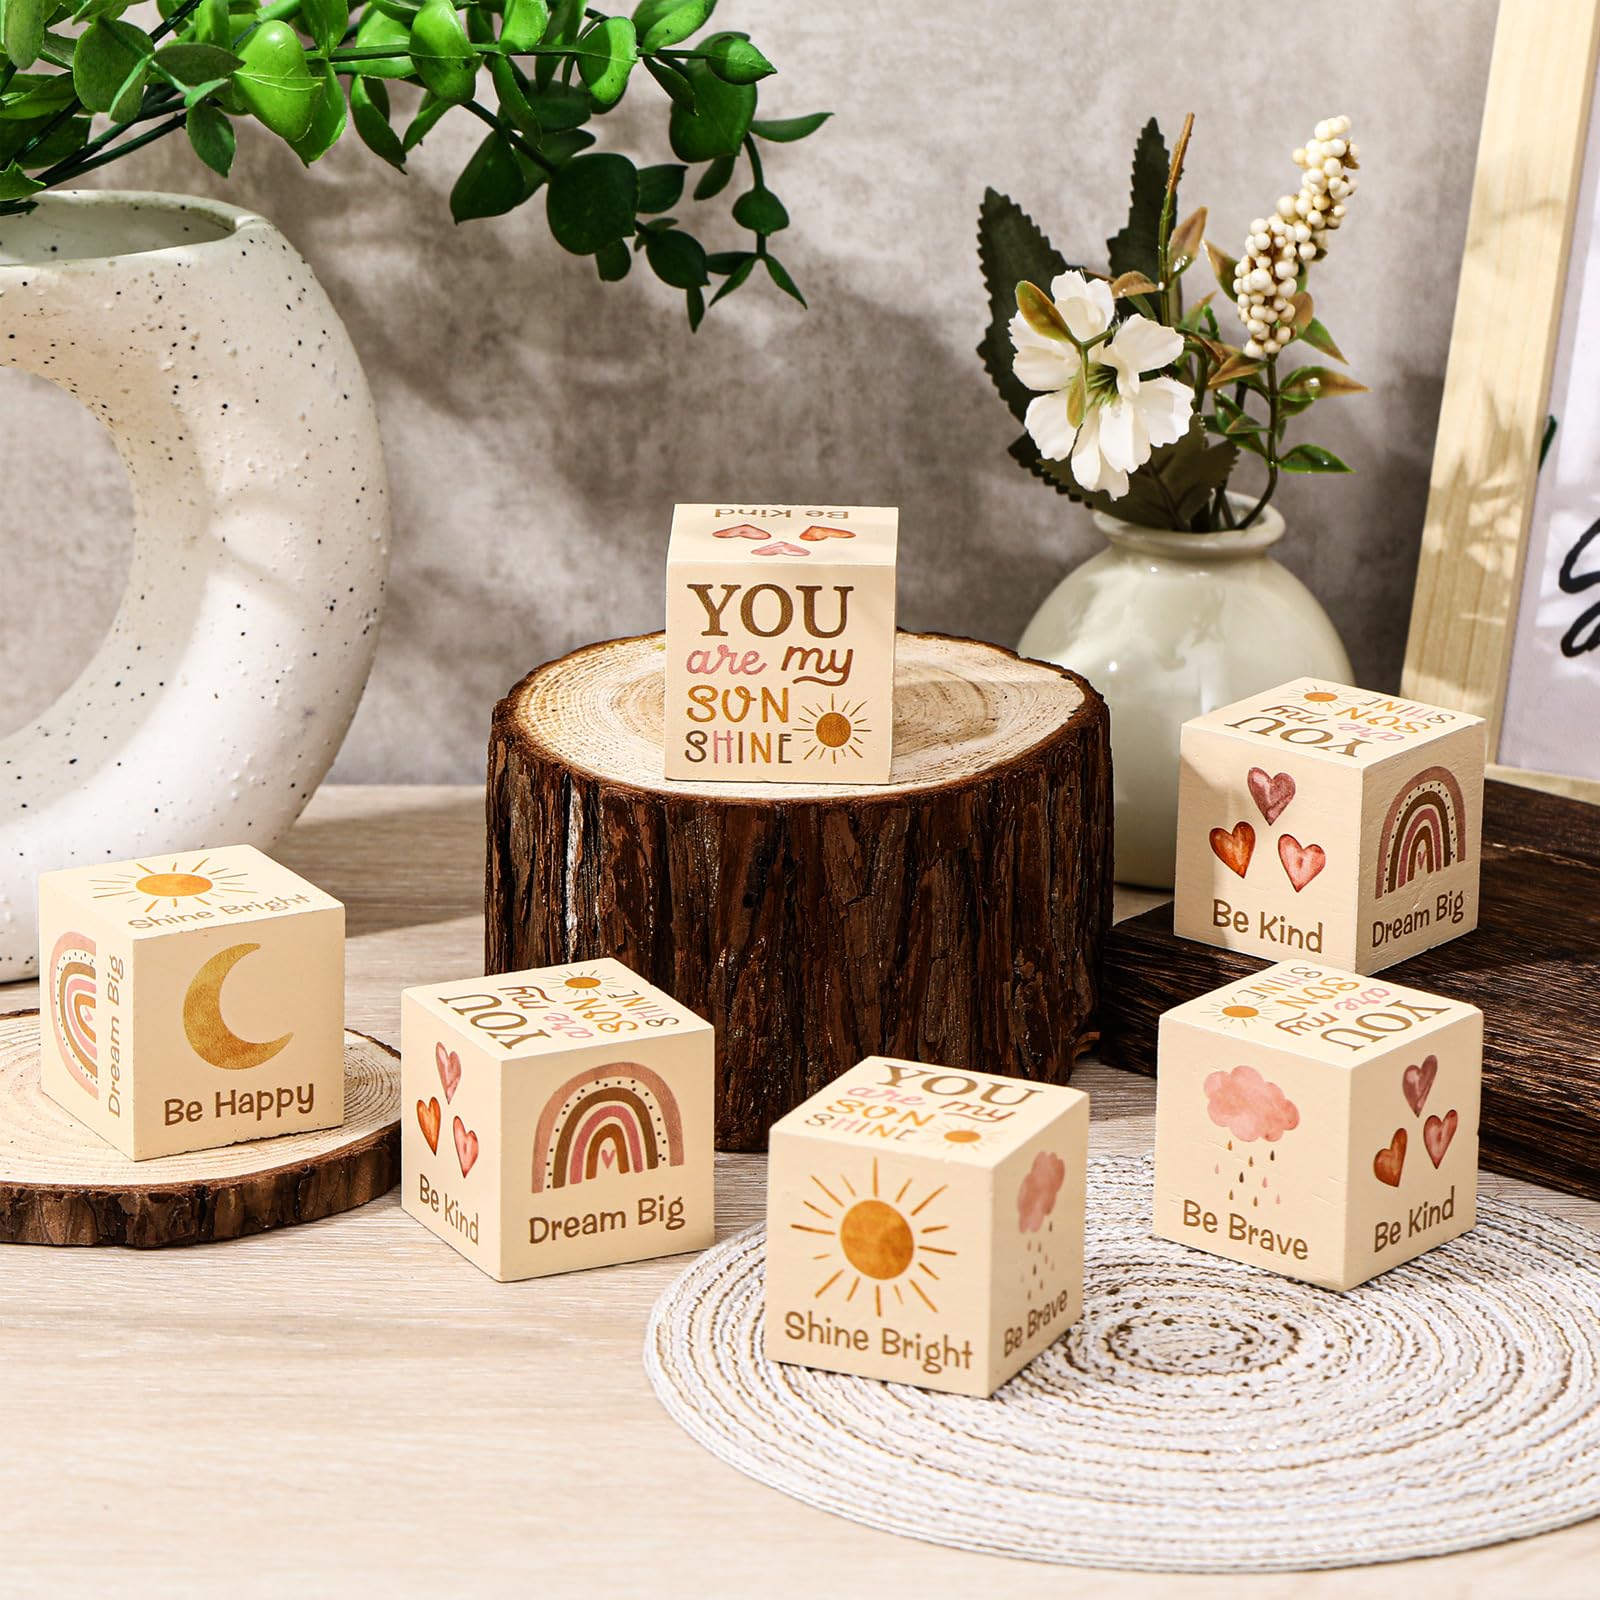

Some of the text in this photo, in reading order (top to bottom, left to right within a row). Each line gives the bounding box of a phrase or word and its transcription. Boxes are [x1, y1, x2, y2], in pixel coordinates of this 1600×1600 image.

[714, 508, 849, 519] Be Kind
[686, 583, 854, 639] YOU
[686, 644, 854, 687] are my
[686, 684, 789, 723] SUN
[1260, 705, 1405, 742] are my
[1334, 706, 1432, 734] SUN
[1358, 696, 1456, 724] SHINE
[685, 730, 793, 764] SHINE
[1224, 716, 1374, 758] YOU
[127, 893, 311, 930] Shine Bright
[1212, 899, 1323, 954] Be Kind
[1372, 890, 1464, 948] Dream Big
[1237, 966, 1322, 1000] SHINE
[1275, 976, 1360, 1010] SUN
[437, 993, 552, 1050] YOU
[498, 985, 594, 1039] are my
[563, 997, 639, 1034] SUN
[606, 989, 680, 1028] SHINE
[1274, 986, 1390, 1036] are my
[1320, 999, 1452, 1052] YOU
[107, 954, 124, 1119] Dream Big
[164, 1082, 315, 1126] Be Happy
[846, 1086, 1016, 1124] are my
[877, 1064, 1044, 1106] YOU
[804, 1113, 918, 1142] SHINE
[826, 1098, 935, 1128] SUN
[419, 1173, 479, 1246] Be Kind
[529, 1194, 686, 1244] Dream Big
[1183, 1199, 1309, 1261] Be Brave
[1374, 1185, 1455, 1253] Be Kind
[784, 1310, 973, 1375] Shine Bright
[1003, 1289, 1068, 1358] Be Brave
